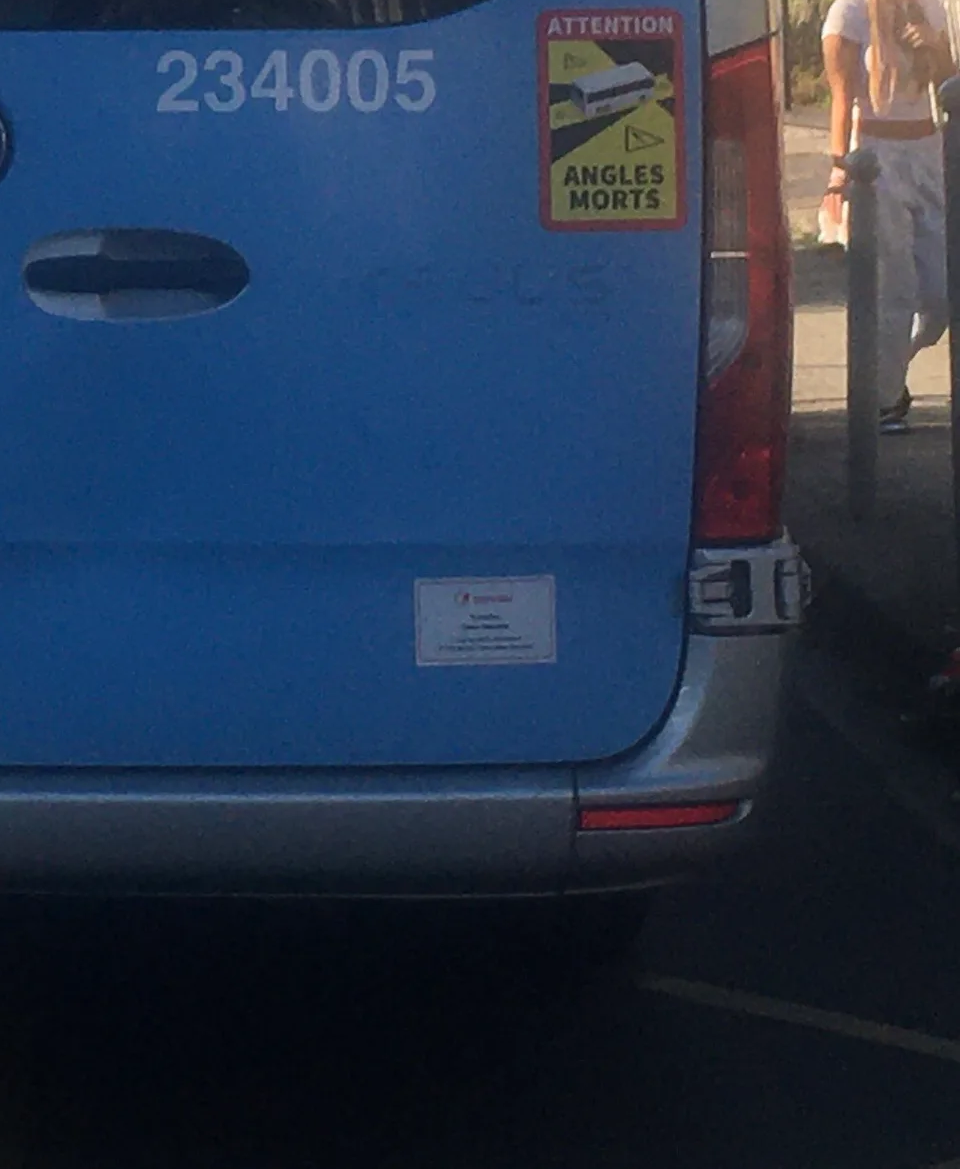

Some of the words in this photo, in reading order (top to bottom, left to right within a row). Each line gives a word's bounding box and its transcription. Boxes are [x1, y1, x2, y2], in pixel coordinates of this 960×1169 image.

[547, 15, 674, 36] ATTENTION
[156, 48, 437, 113] 234005
[563, 164, 666, 186] ANGLES
[569, 187, 661, 210] MORTS
